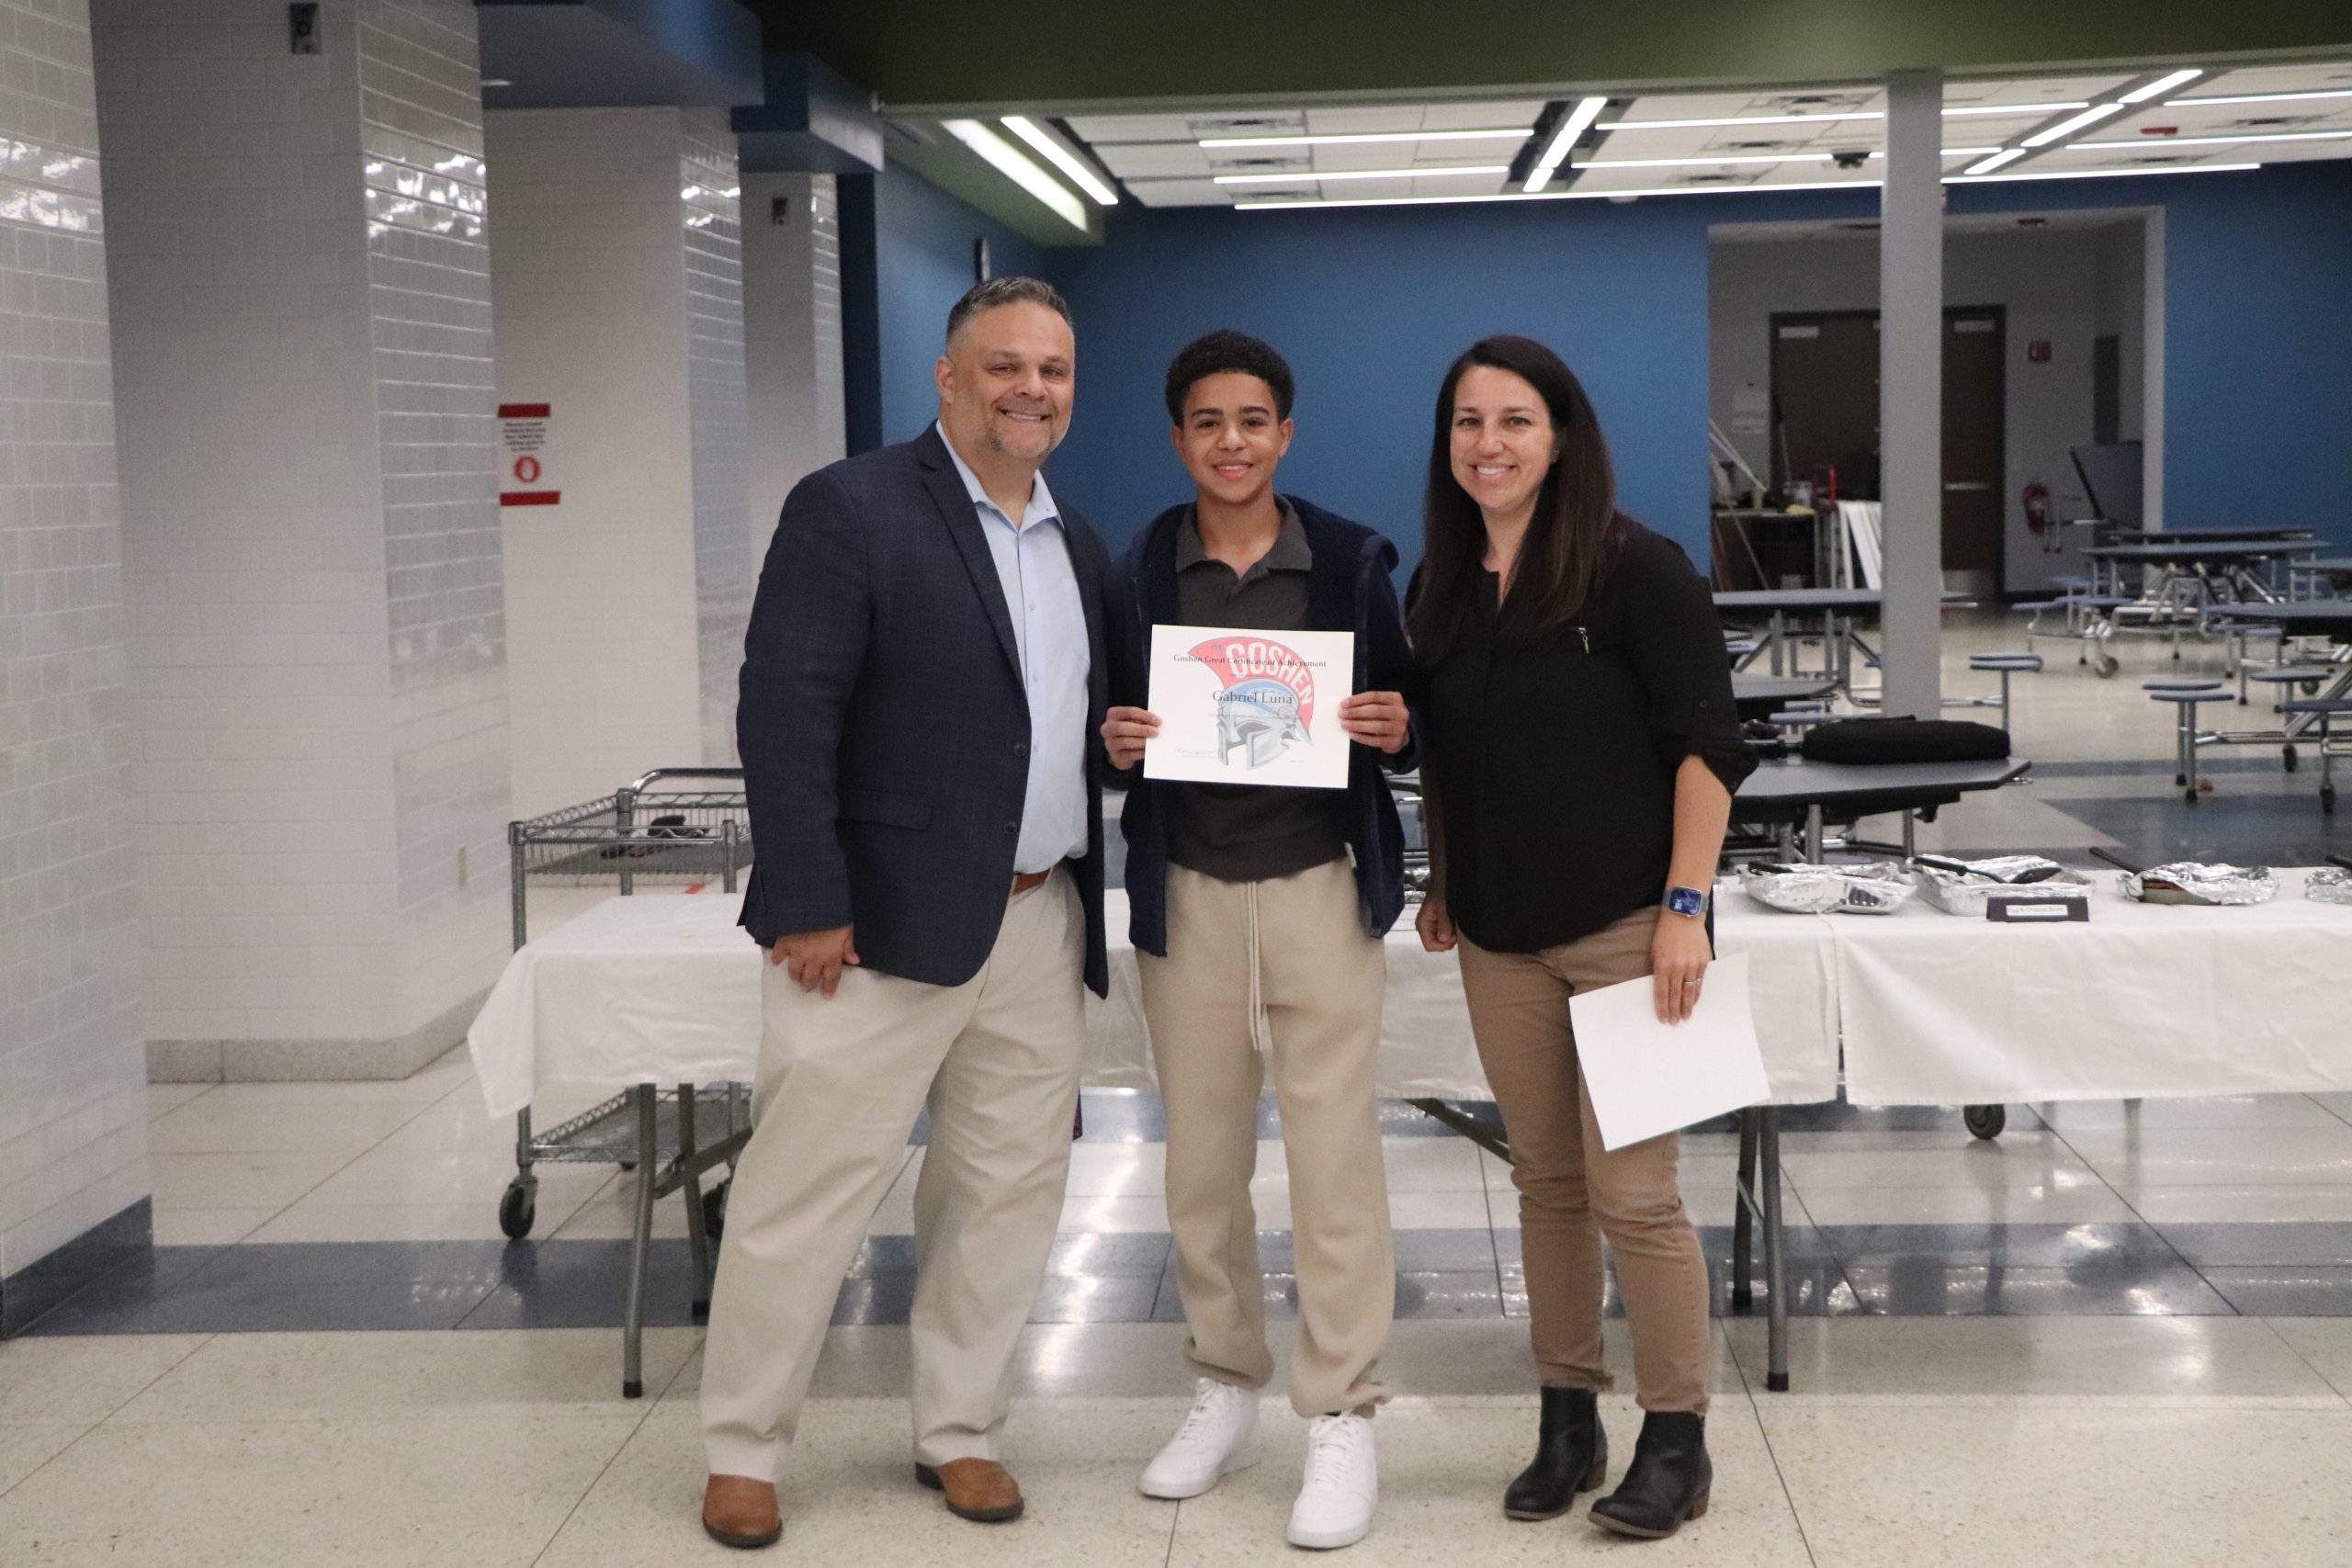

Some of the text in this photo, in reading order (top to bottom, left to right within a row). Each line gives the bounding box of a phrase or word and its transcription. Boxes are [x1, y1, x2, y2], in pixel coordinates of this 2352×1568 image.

[1173, 654, 1327, 668] Goshen Great Certificate of Achievement
[1226, 642, 1312, 705] GOSHEN
[1212, 691, 1294, 705] Gabriel Luna
